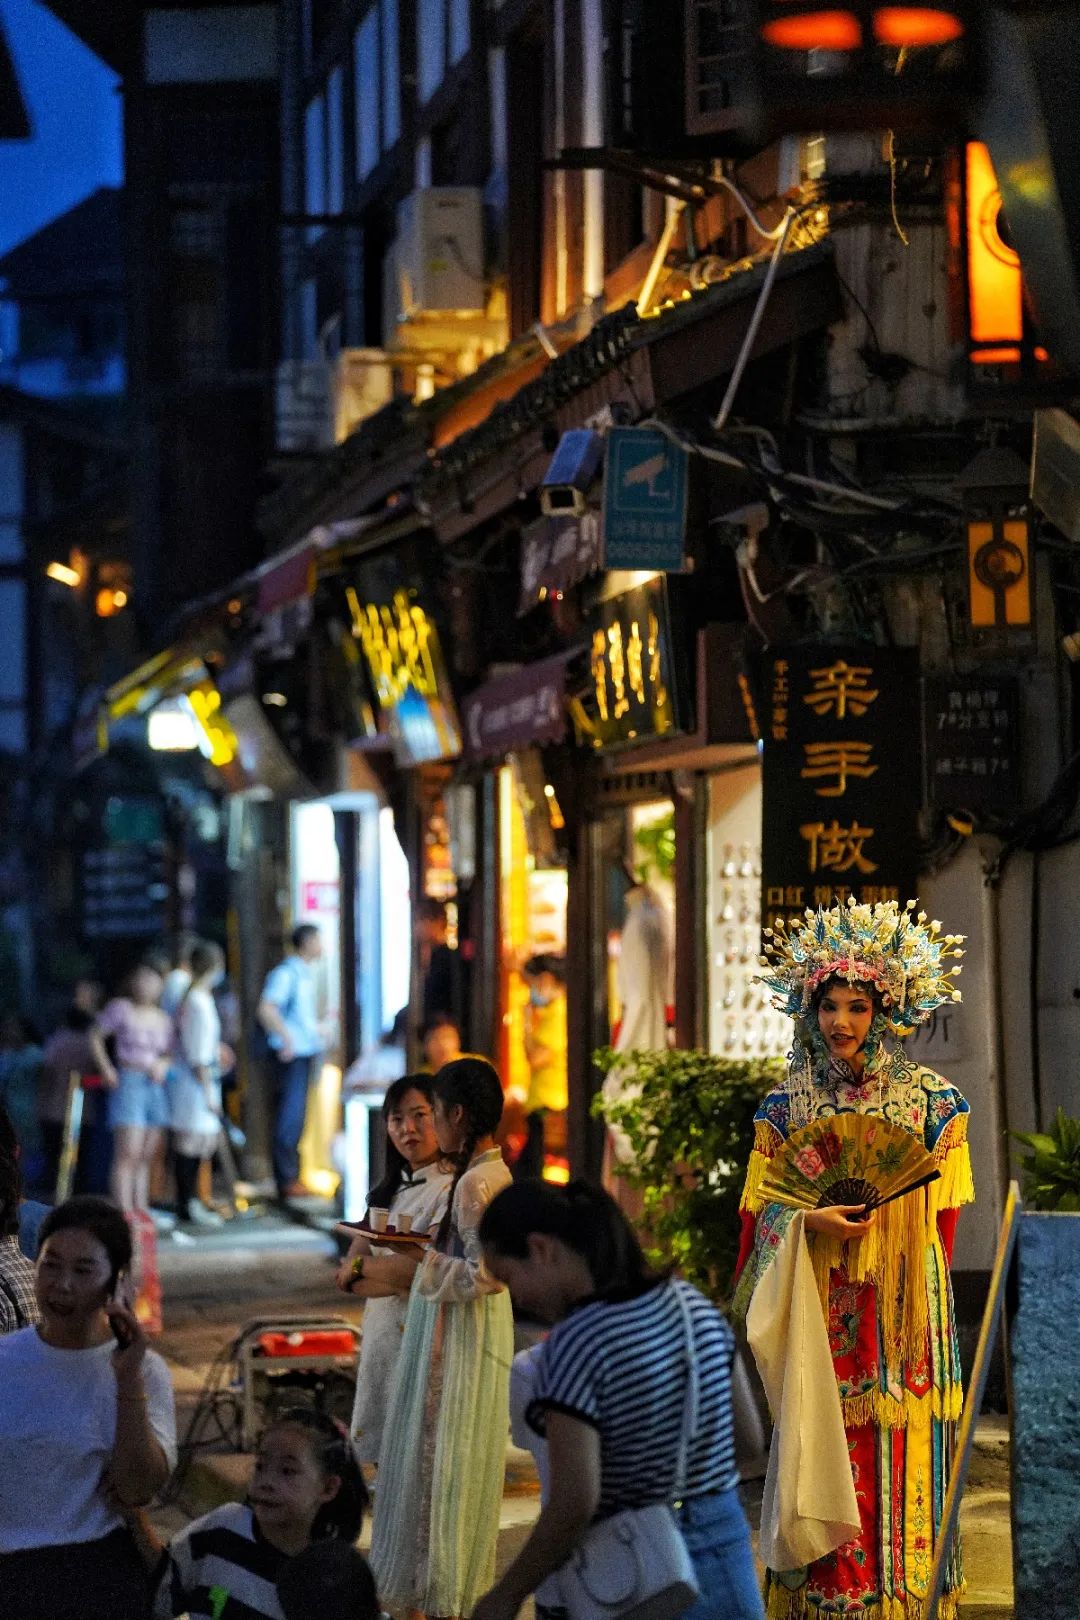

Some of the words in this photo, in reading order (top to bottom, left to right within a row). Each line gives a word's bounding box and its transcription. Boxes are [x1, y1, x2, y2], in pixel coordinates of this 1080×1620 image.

[799, 658, 880, 875] 亲手做
[766, 885, 805, 906] 口红
